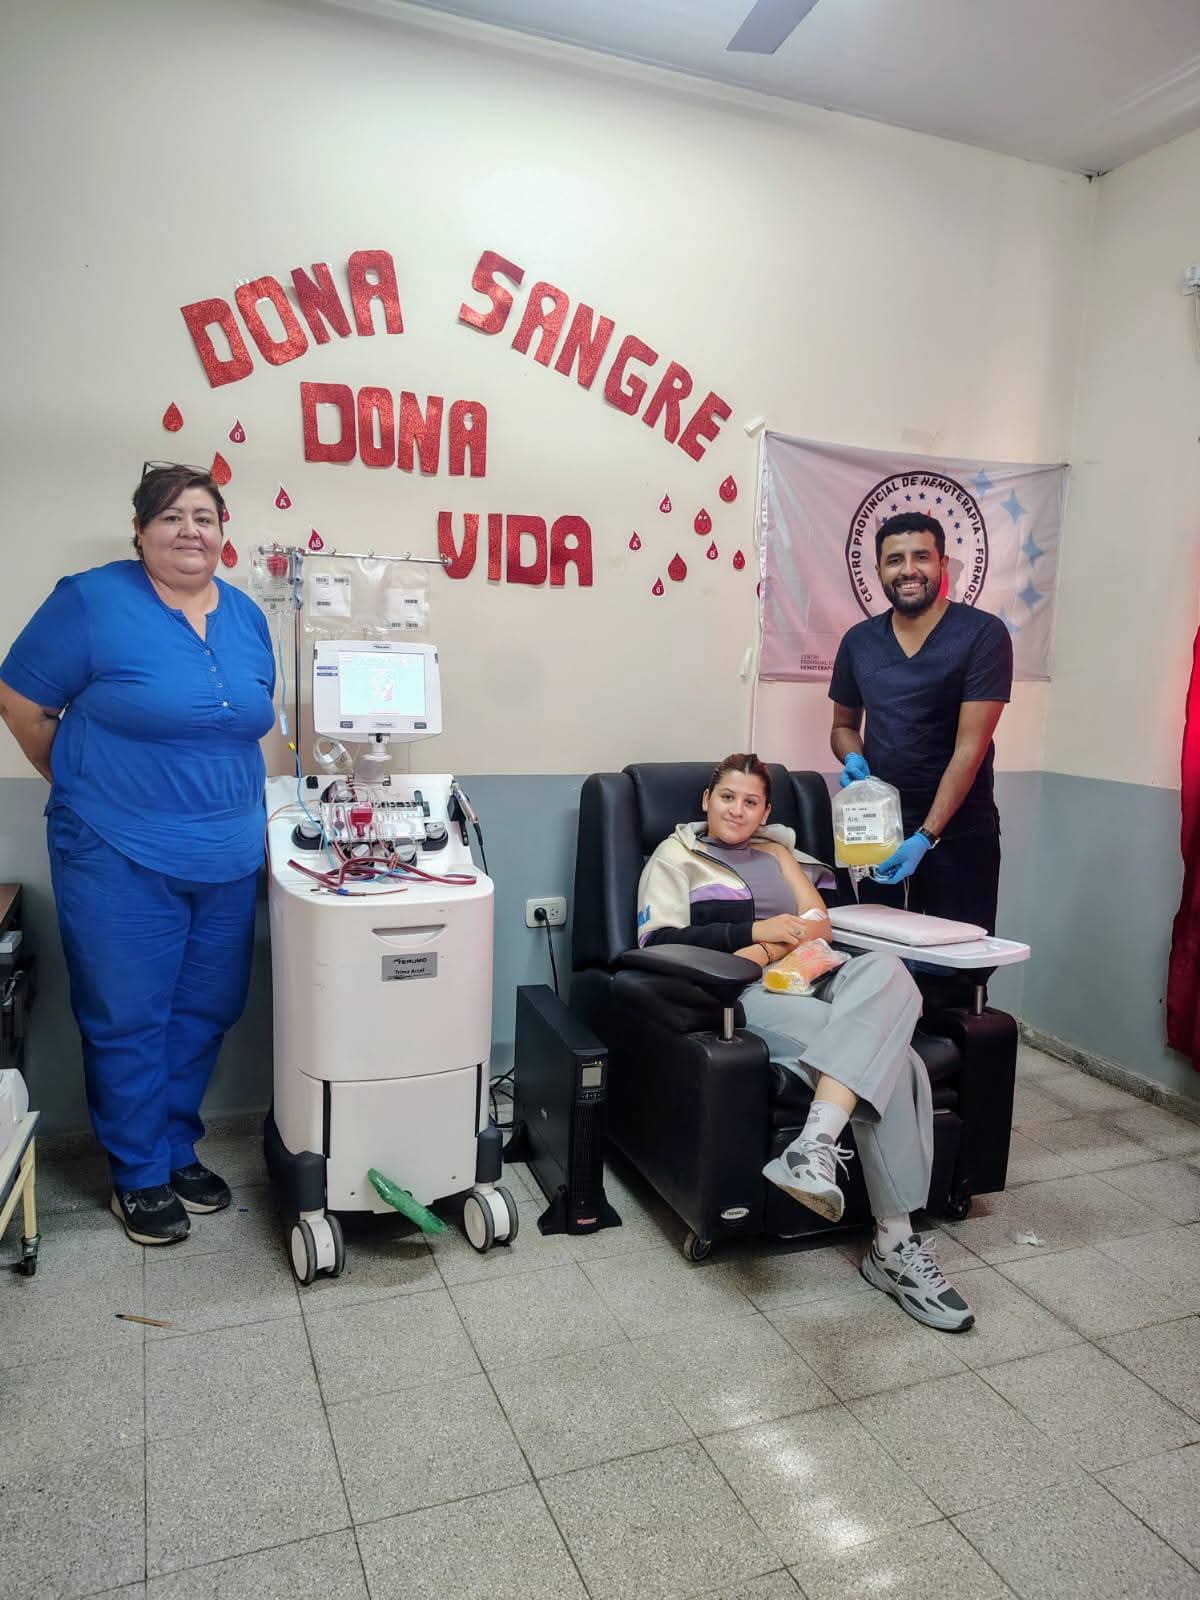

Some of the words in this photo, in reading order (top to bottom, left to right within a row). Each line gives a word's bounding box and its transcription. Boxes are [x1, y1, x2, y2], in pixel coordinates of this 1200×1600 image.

[180, 249, 404, 389] DONA
[458, 250, 732, 462] SANGRE
[300, 382, 487, 478] DONA
[854, 481, 900, 547] PROVINCIAL
[902, 476, 919, 487] DE
[920, 476, 983, 535] HEMOTERAPIA
[438, 511, 594, 588] VIDA
[851, 550, 873, 603] CENTRO
